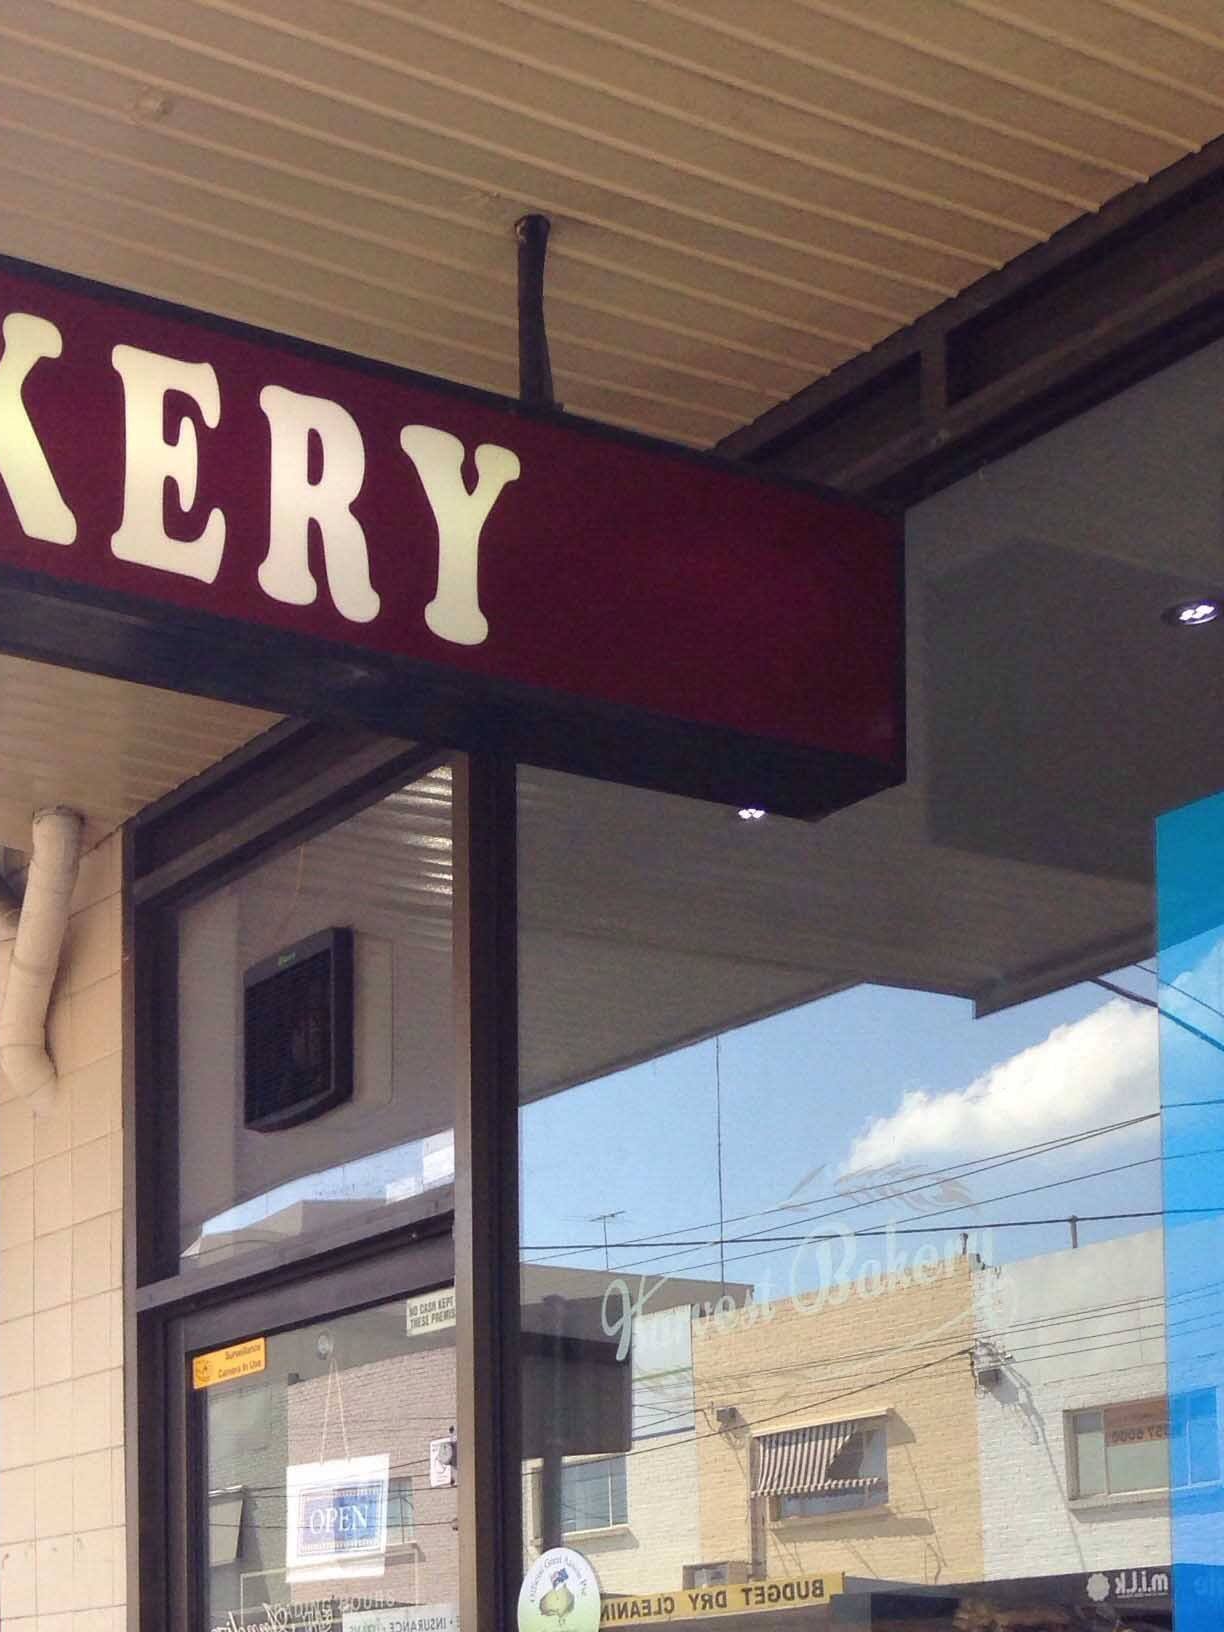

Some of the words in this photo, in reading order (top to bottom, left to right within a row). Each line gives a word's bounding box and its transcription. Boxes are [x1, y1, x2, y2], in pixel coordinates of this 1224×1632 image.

[409, 1302, 419, 1316] NO
[419, 1300, 437, 1313] CASH
[437, 1296, 455, 1309] KEPT
[410, 1317, 430, 1329] THESE
[225, 1343, 262, 1361] Surveillance
[218, 1364, 242, 1379] Camera
[250, 1358, 262, 1370] Use
[309, 1505, 369, 1535] OPEN
